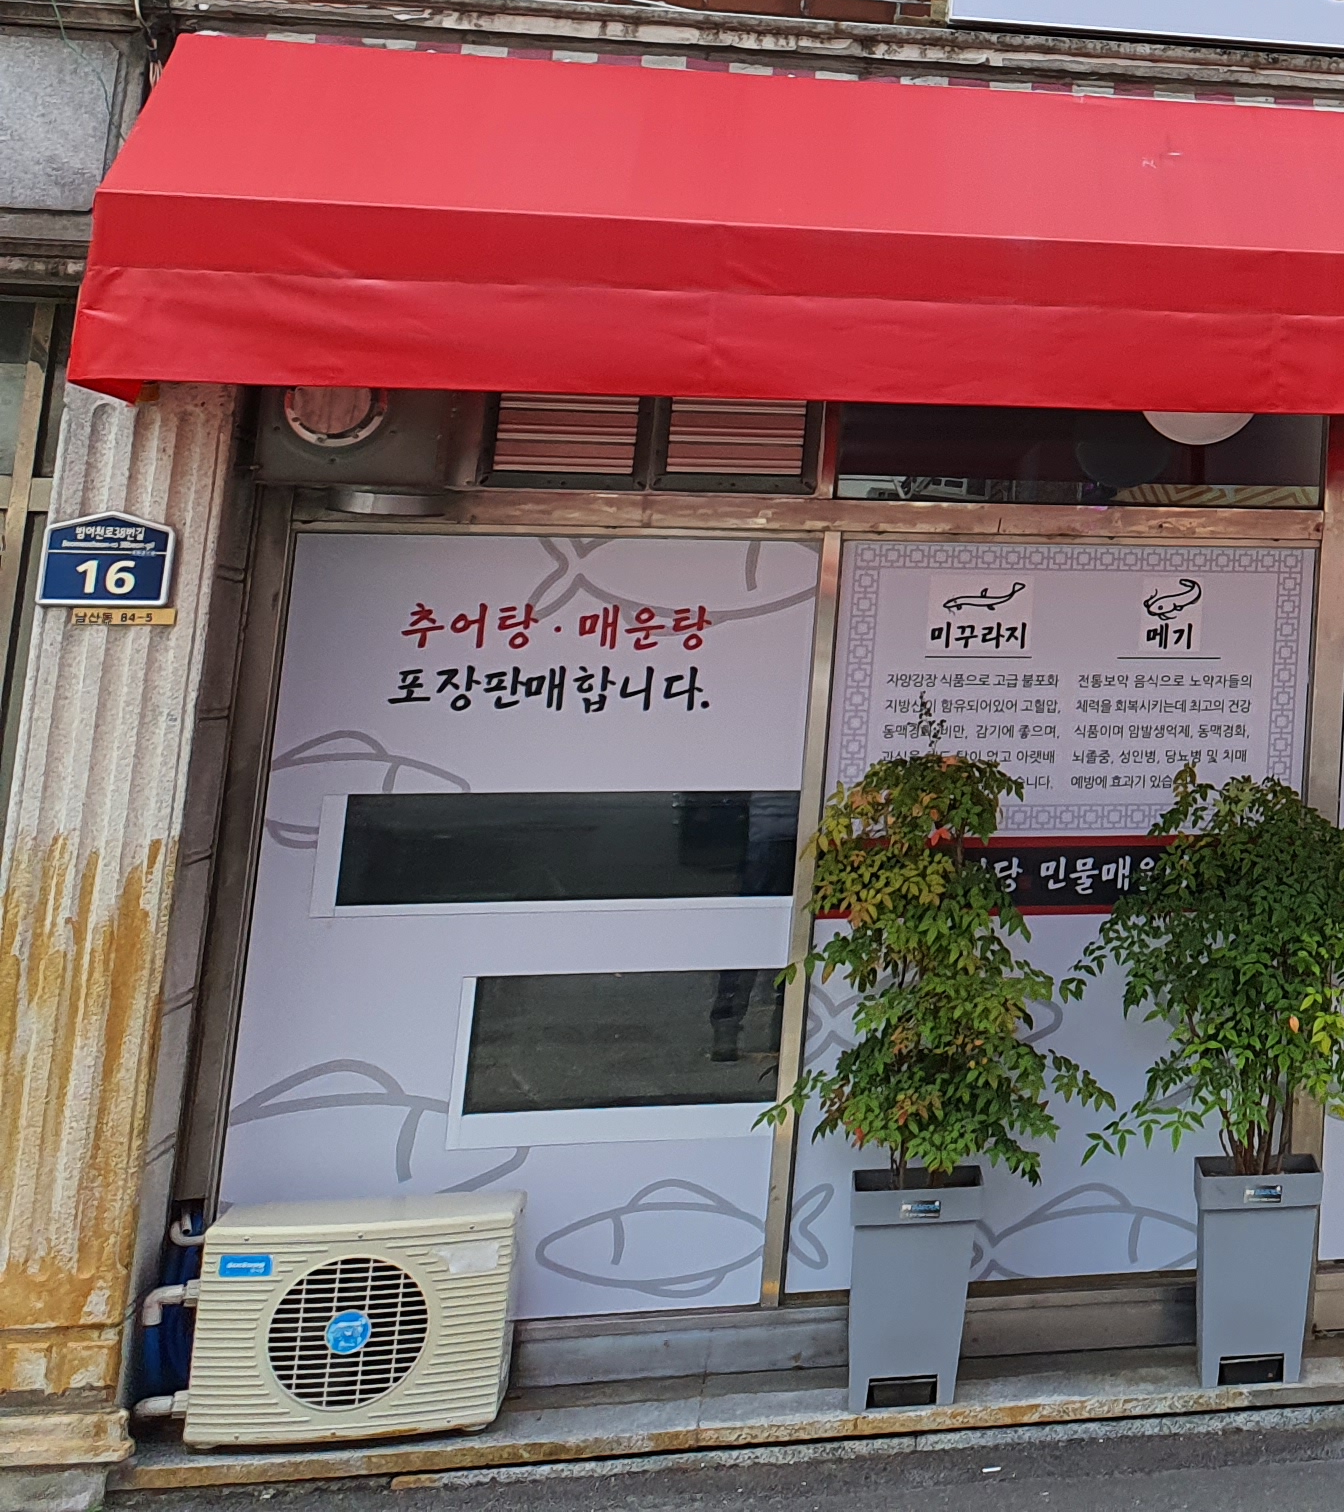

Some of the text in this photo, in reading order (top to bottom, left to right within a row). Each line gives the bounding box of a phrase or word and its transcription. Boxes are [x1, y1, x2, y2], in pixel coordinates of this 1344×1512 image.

[76, 559, 136, 595] 16
[120, 613, 153, 623] 84-5
[401, 603, 712, 651] 추어탕 매운탕
[931, 622, 1028, 650] 미꾸라지
[1146, 623, 1194, 649] 메기
[940, 674, 990, 688] 식품으로
[993, 674, 1018, 688] 고급
[1078, 674, 1129, 688] 전통보약
[1134, 674, 1184, 688] 음식으로
[387, 665, 711, 713] 포장판매합니다.
[1076, 699, 1251, 713] 체력을 회복시키는데 최고의 건강
[976, 724, 1015, 739] 감기에
[1074, 724, 1124, 738] 식품이며
[1223, 750, 1248, 764] 치매
